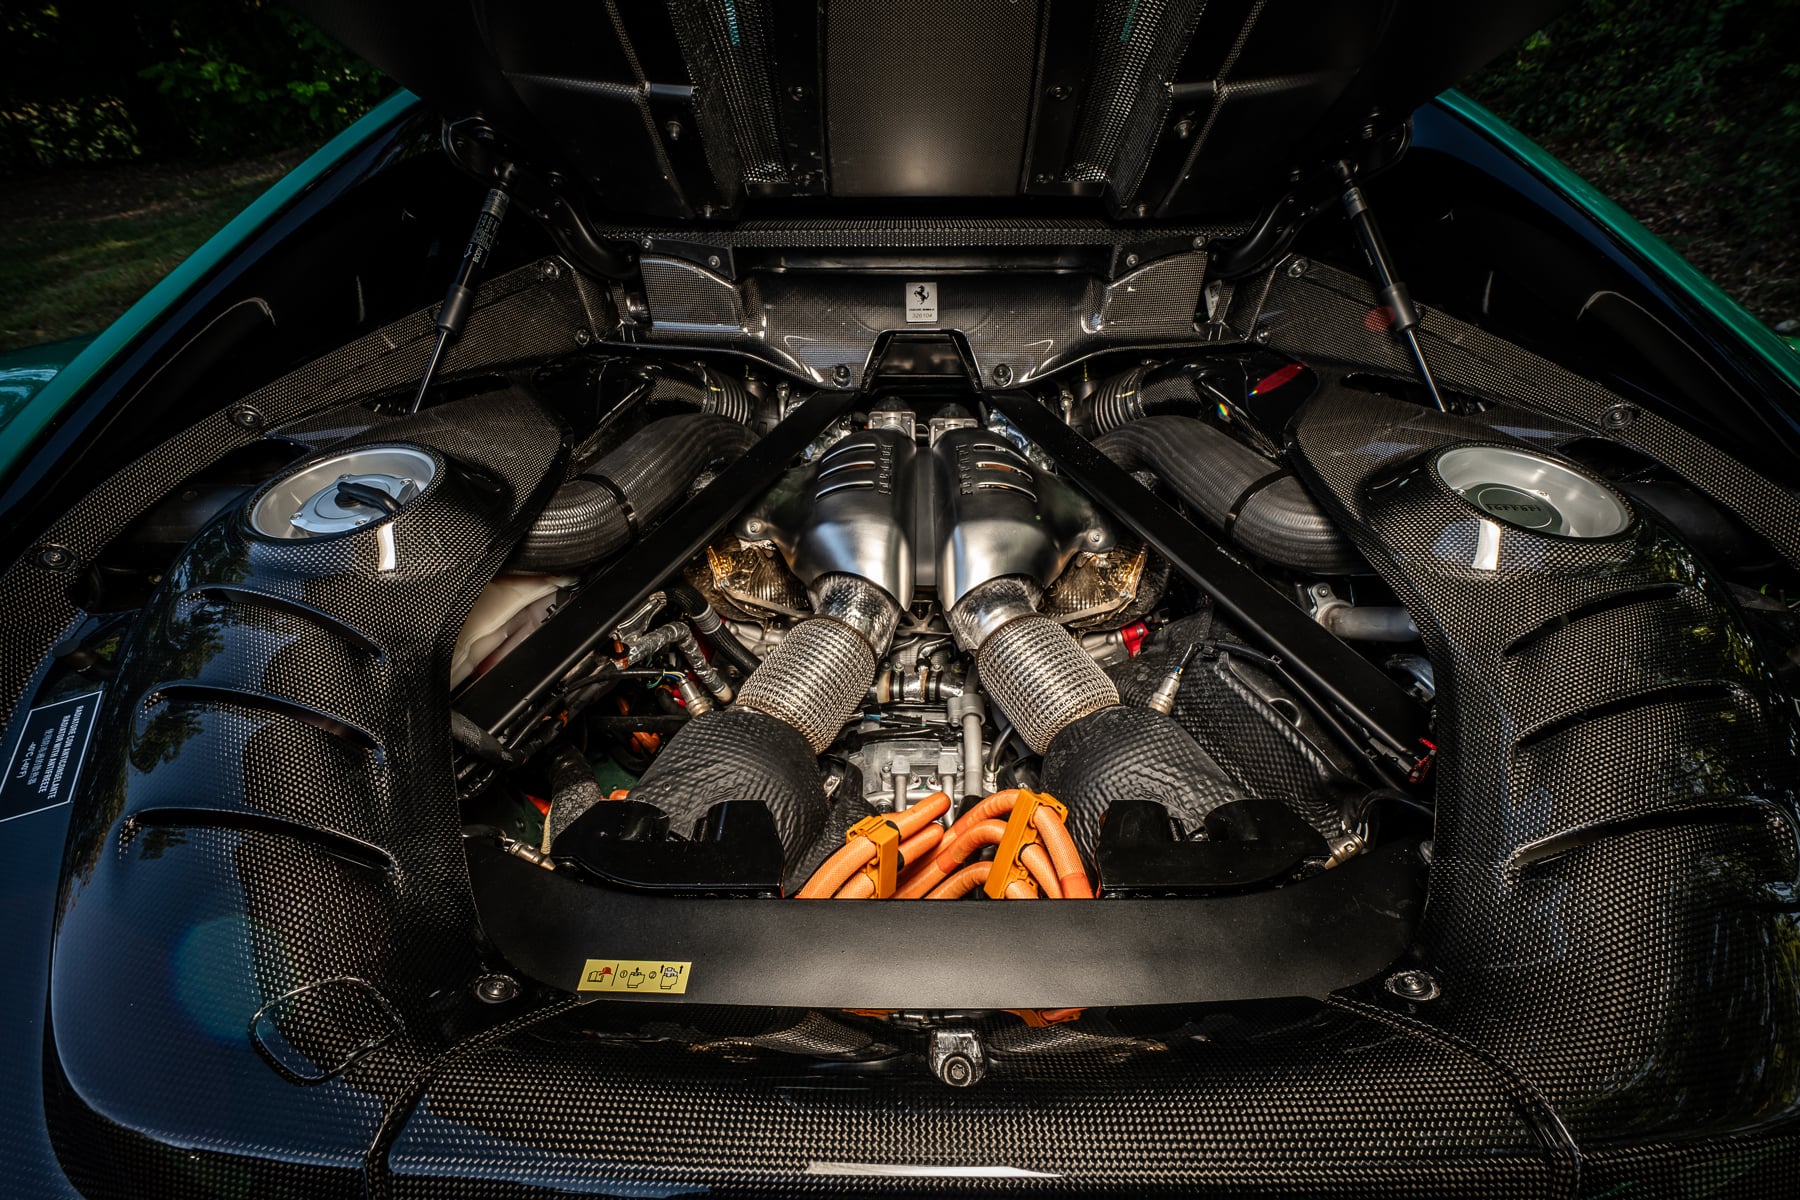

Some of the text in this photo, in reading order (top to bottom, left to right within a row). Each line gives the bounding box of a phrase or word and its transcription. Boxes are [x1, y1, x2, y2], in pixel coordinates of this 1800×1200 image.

[55, 714, 71, 744] RADIATOR
[47, 705, 84, 800] RADIATORE CON ANTICONGELANTE
[50, 742, 62, 757] WITH
[38, 758, 57, 794] ANTIFREEZE
